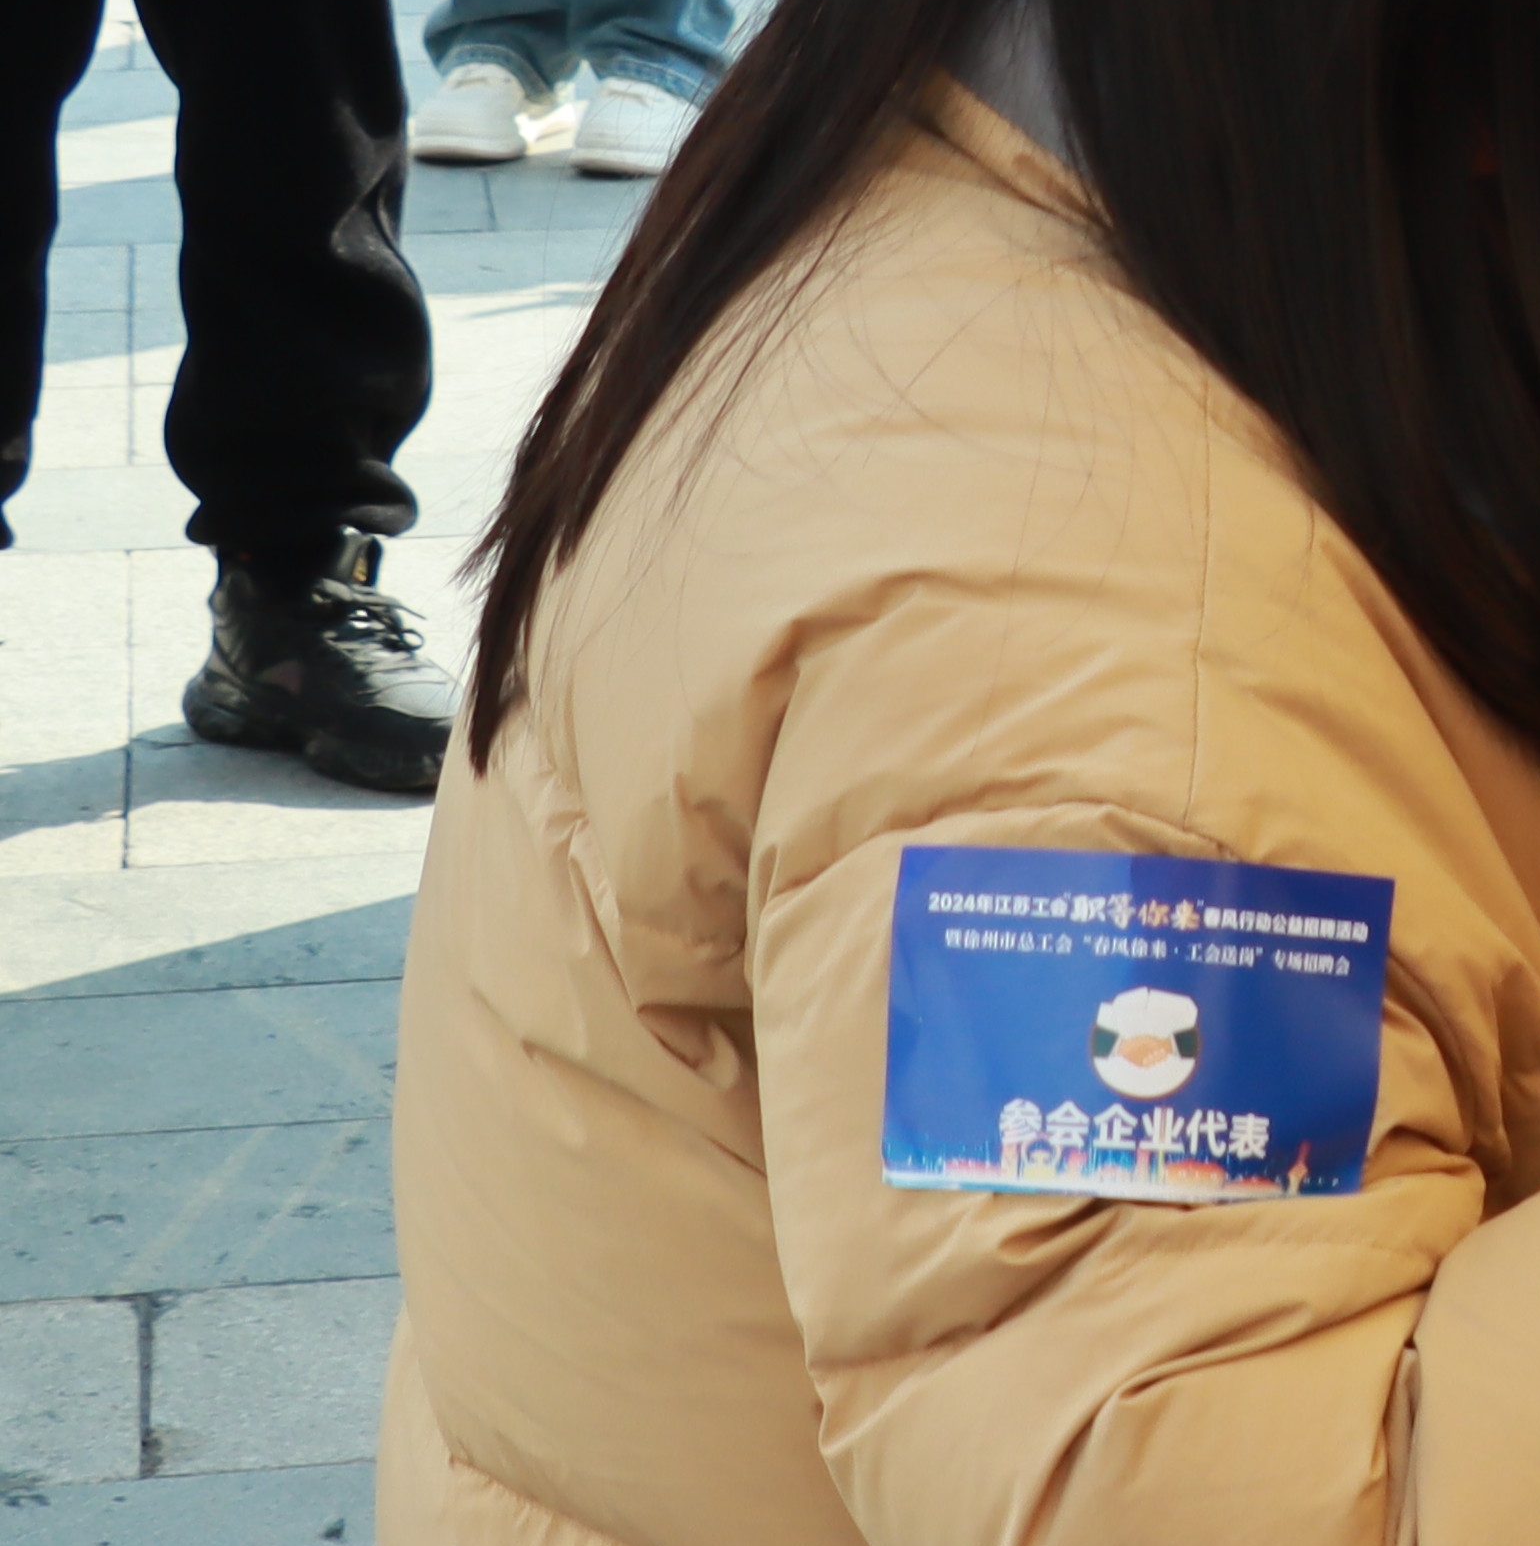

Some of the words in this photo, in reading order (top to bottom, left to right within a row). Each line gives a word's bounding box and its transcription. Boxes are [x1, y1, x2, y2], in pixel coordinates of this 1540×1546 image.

[999, 1096, 1271, 1161] 参会企业代表
